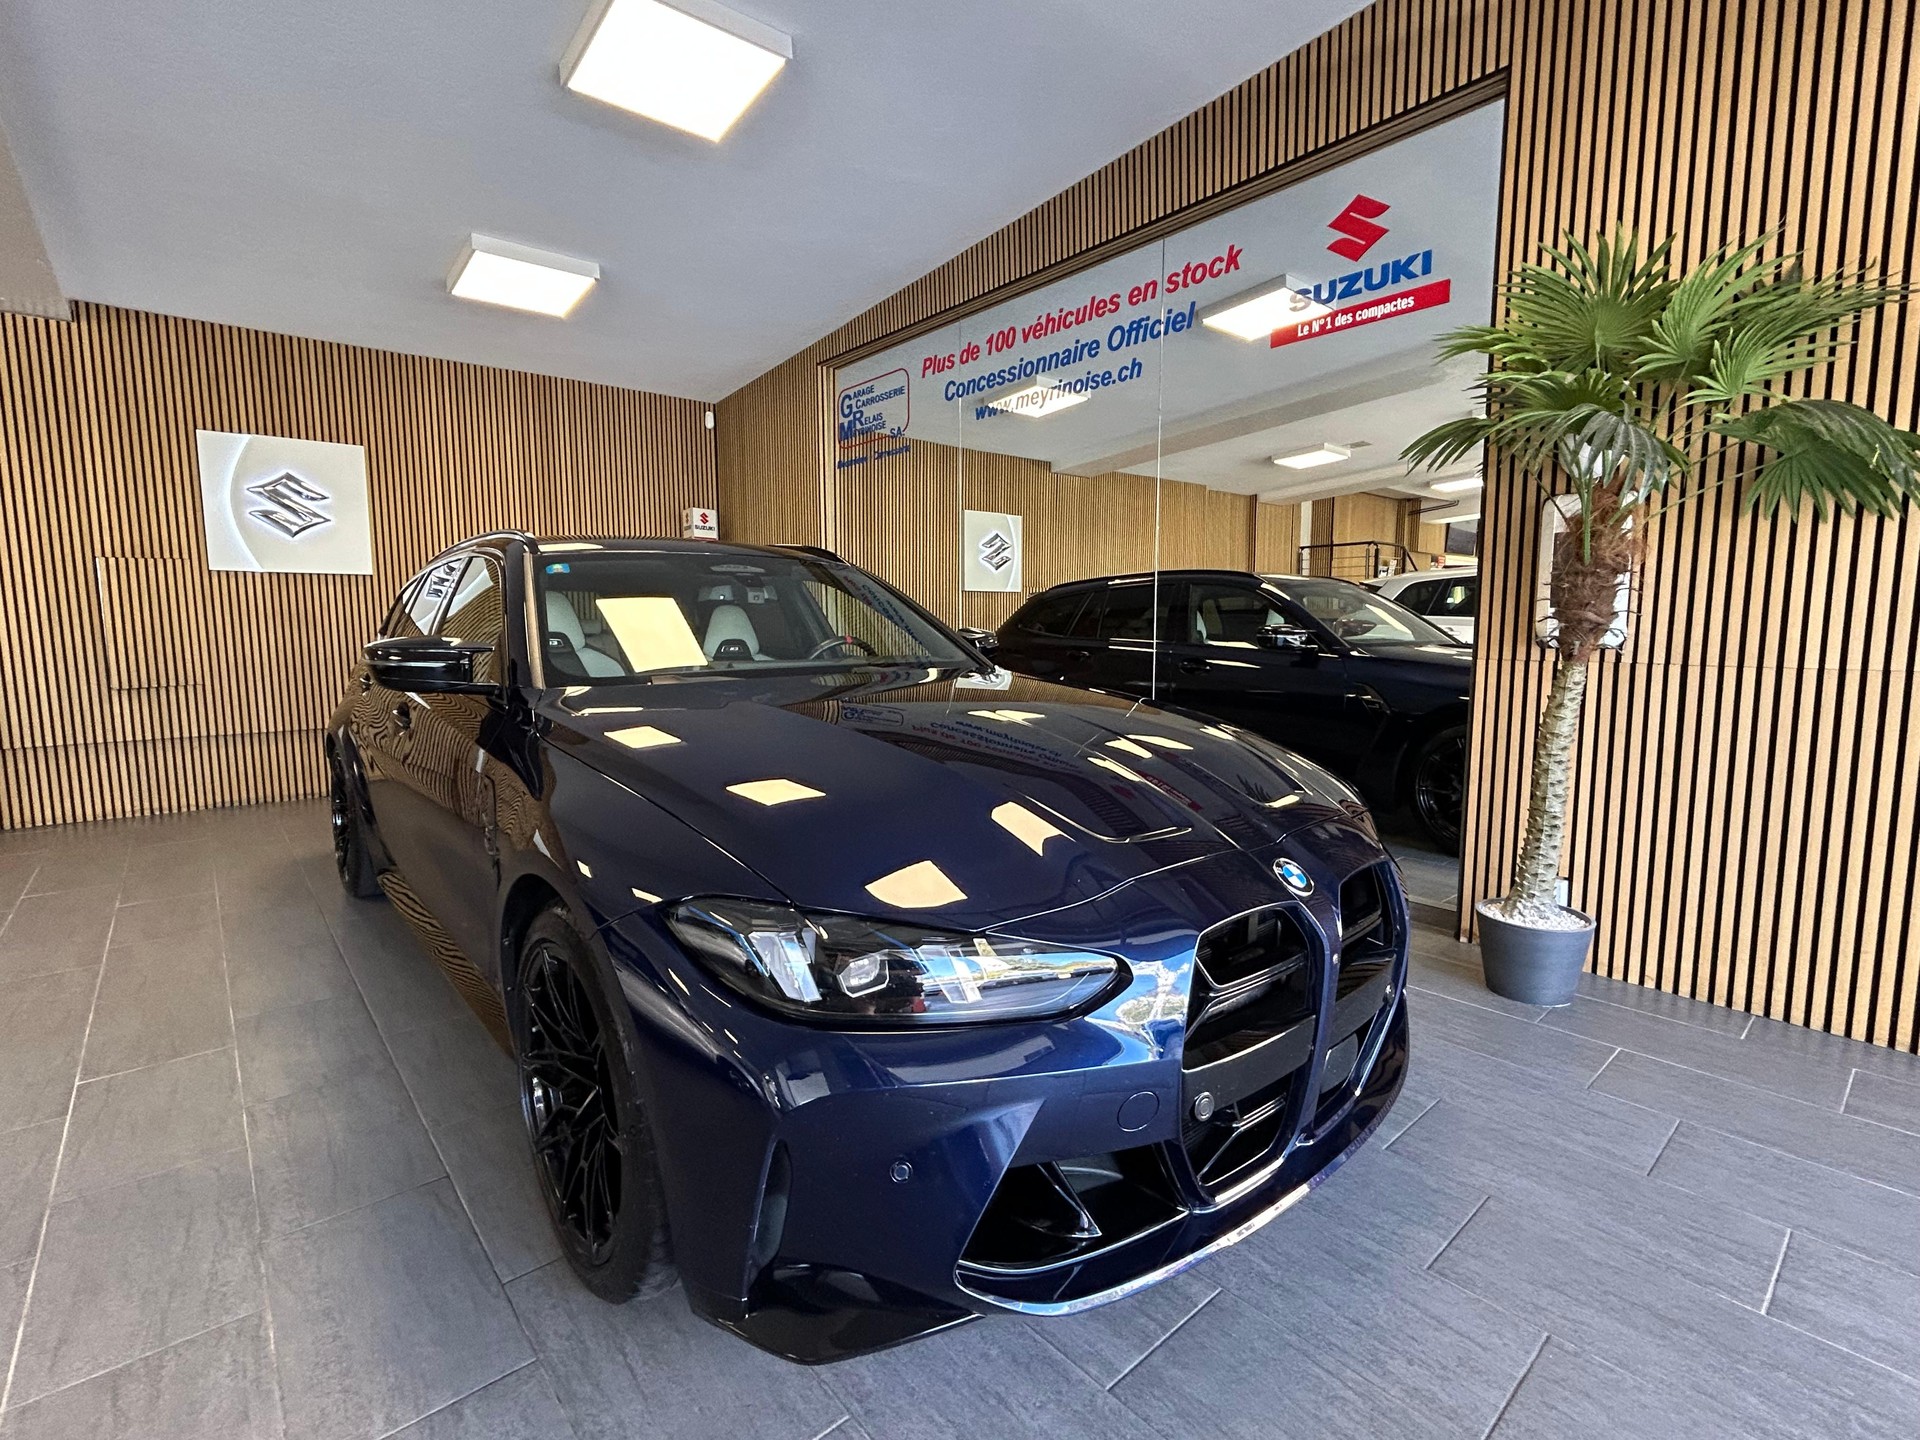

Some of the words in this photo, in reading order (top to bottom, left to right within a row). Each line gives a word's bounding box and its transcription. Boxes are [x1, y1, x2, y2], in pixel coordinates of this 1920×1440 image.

[1289, 249, 1432, 312] SUZUKI
[921, 354, 955, 378] Plus
[959, 342, 980, 365] de
[986, 326, 1016, 355] 100
[1021, 292, 1121, 344] véhicules
[1127, 279, 1158, 306] en
[1165, 244, 1243, 293] stock
[1297, 324, 1309, 337] Le
[1335, 312, 1353, 326] des
[1355, 295, 1415, 321] compactes
[944, 339, 1100, 401] Concessionnaire
[1107, 301, 1196, 352] Officiel
[840, 384, 875, 419] GARAGE
[855, 385, 906, 410] CARROSSERIE
[975, 357, 1143, 420] www.meyrinoise.ch
[852, 409, 884, 429] RELAIS
